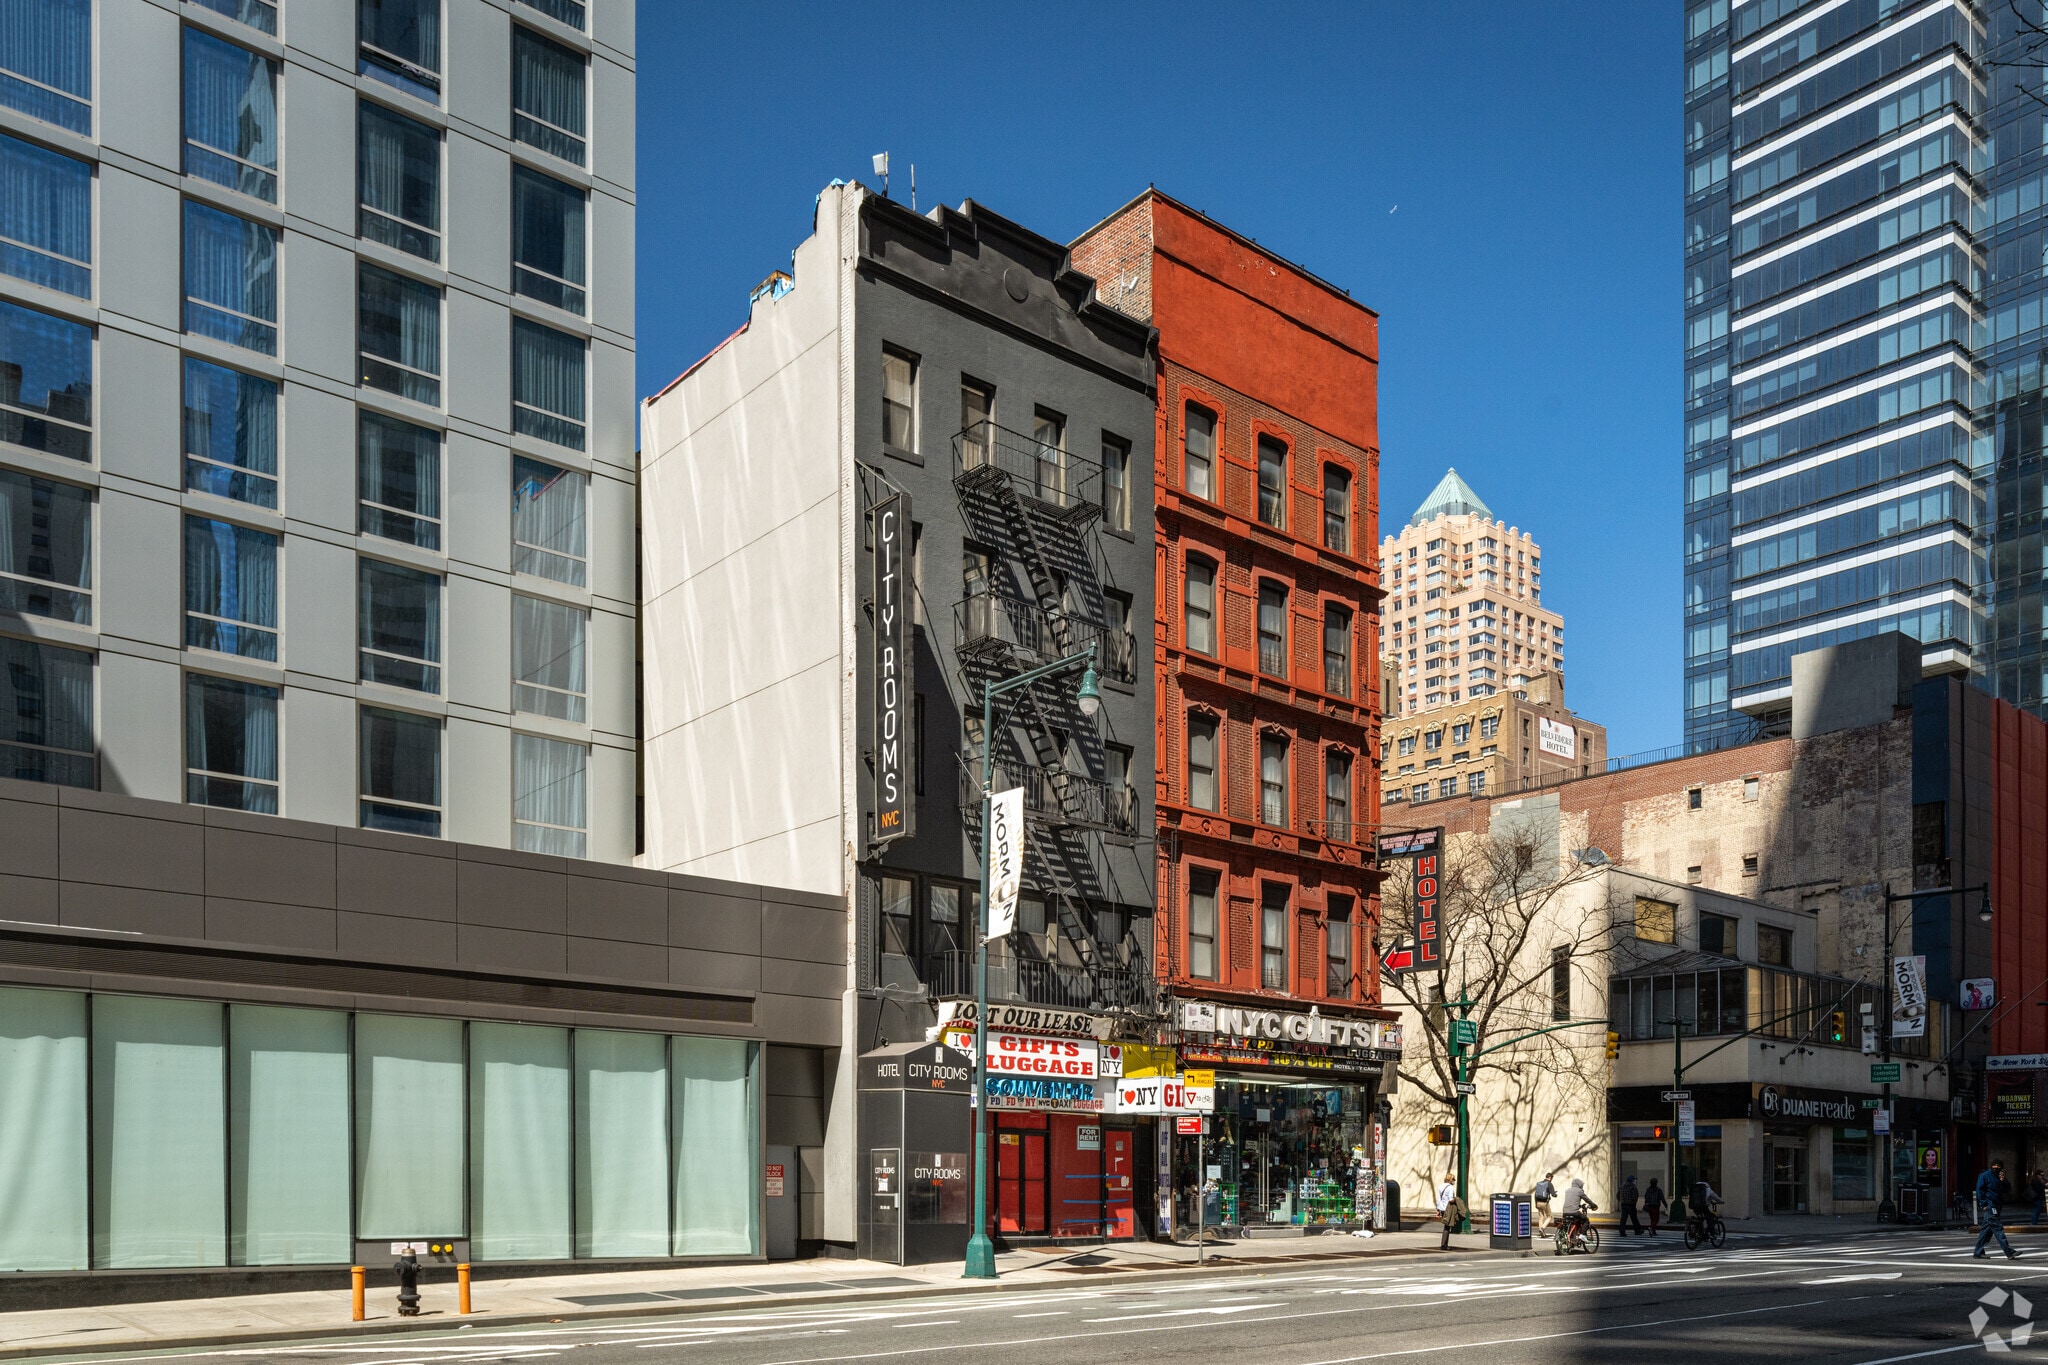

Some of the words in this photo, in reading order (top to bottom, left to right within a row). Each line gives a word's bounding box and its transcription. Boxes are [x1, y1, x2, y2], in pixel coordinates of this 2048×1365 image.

[882, 511, 894, 636] CITY
[883, 647, 897, 803] ROOMS
[1541, 730, 1573, 746] BELVEDERE
[1547, 741, 1568, 754] HOTEL
[881, 810, 899, 829] NYC
[1418, 856, 1437, 961] HOTEL
[1003, 1006, 1039, 1028] OUR
[1041, 1013, 1093, 1034] LEASE
[1219, 1007, 1281, 1039] NYC
[999, 1035, 1079, 1057] GIFTS
[986, 1055, 1094, 1076] LUGGAGE
[1101, 1060, 1121, 1075] NY
[1272, 1053, 1304, 1067] 10%
[1307, 1056, 1334, 1069] OFF
[877, 1063, 901, 1077] HOTEL
[908, 1063, 931, 1078] CITY
[933, 1066, 968, 1080] ROOMS
[931, 1080, 946, 1088] NYC
[990, 1097, 1001, 1106] PD
[1006, 1098, 1016, 1107] FD
[1025, 1098, 1036, 1107] NY
[1118, 1089, 1125, 1106] I
[1136, 1086, 1158, 1106] NY
[1164, 1084, 1185, 1108] GI
[1997, 1095, 2031, 1103] BROADWAY
[1073, 1100, 1104, 1110] LUGGAGE
[914, 1168, 932, 1179] CITY
[933, 1169, 961, 1180] ROOMS
